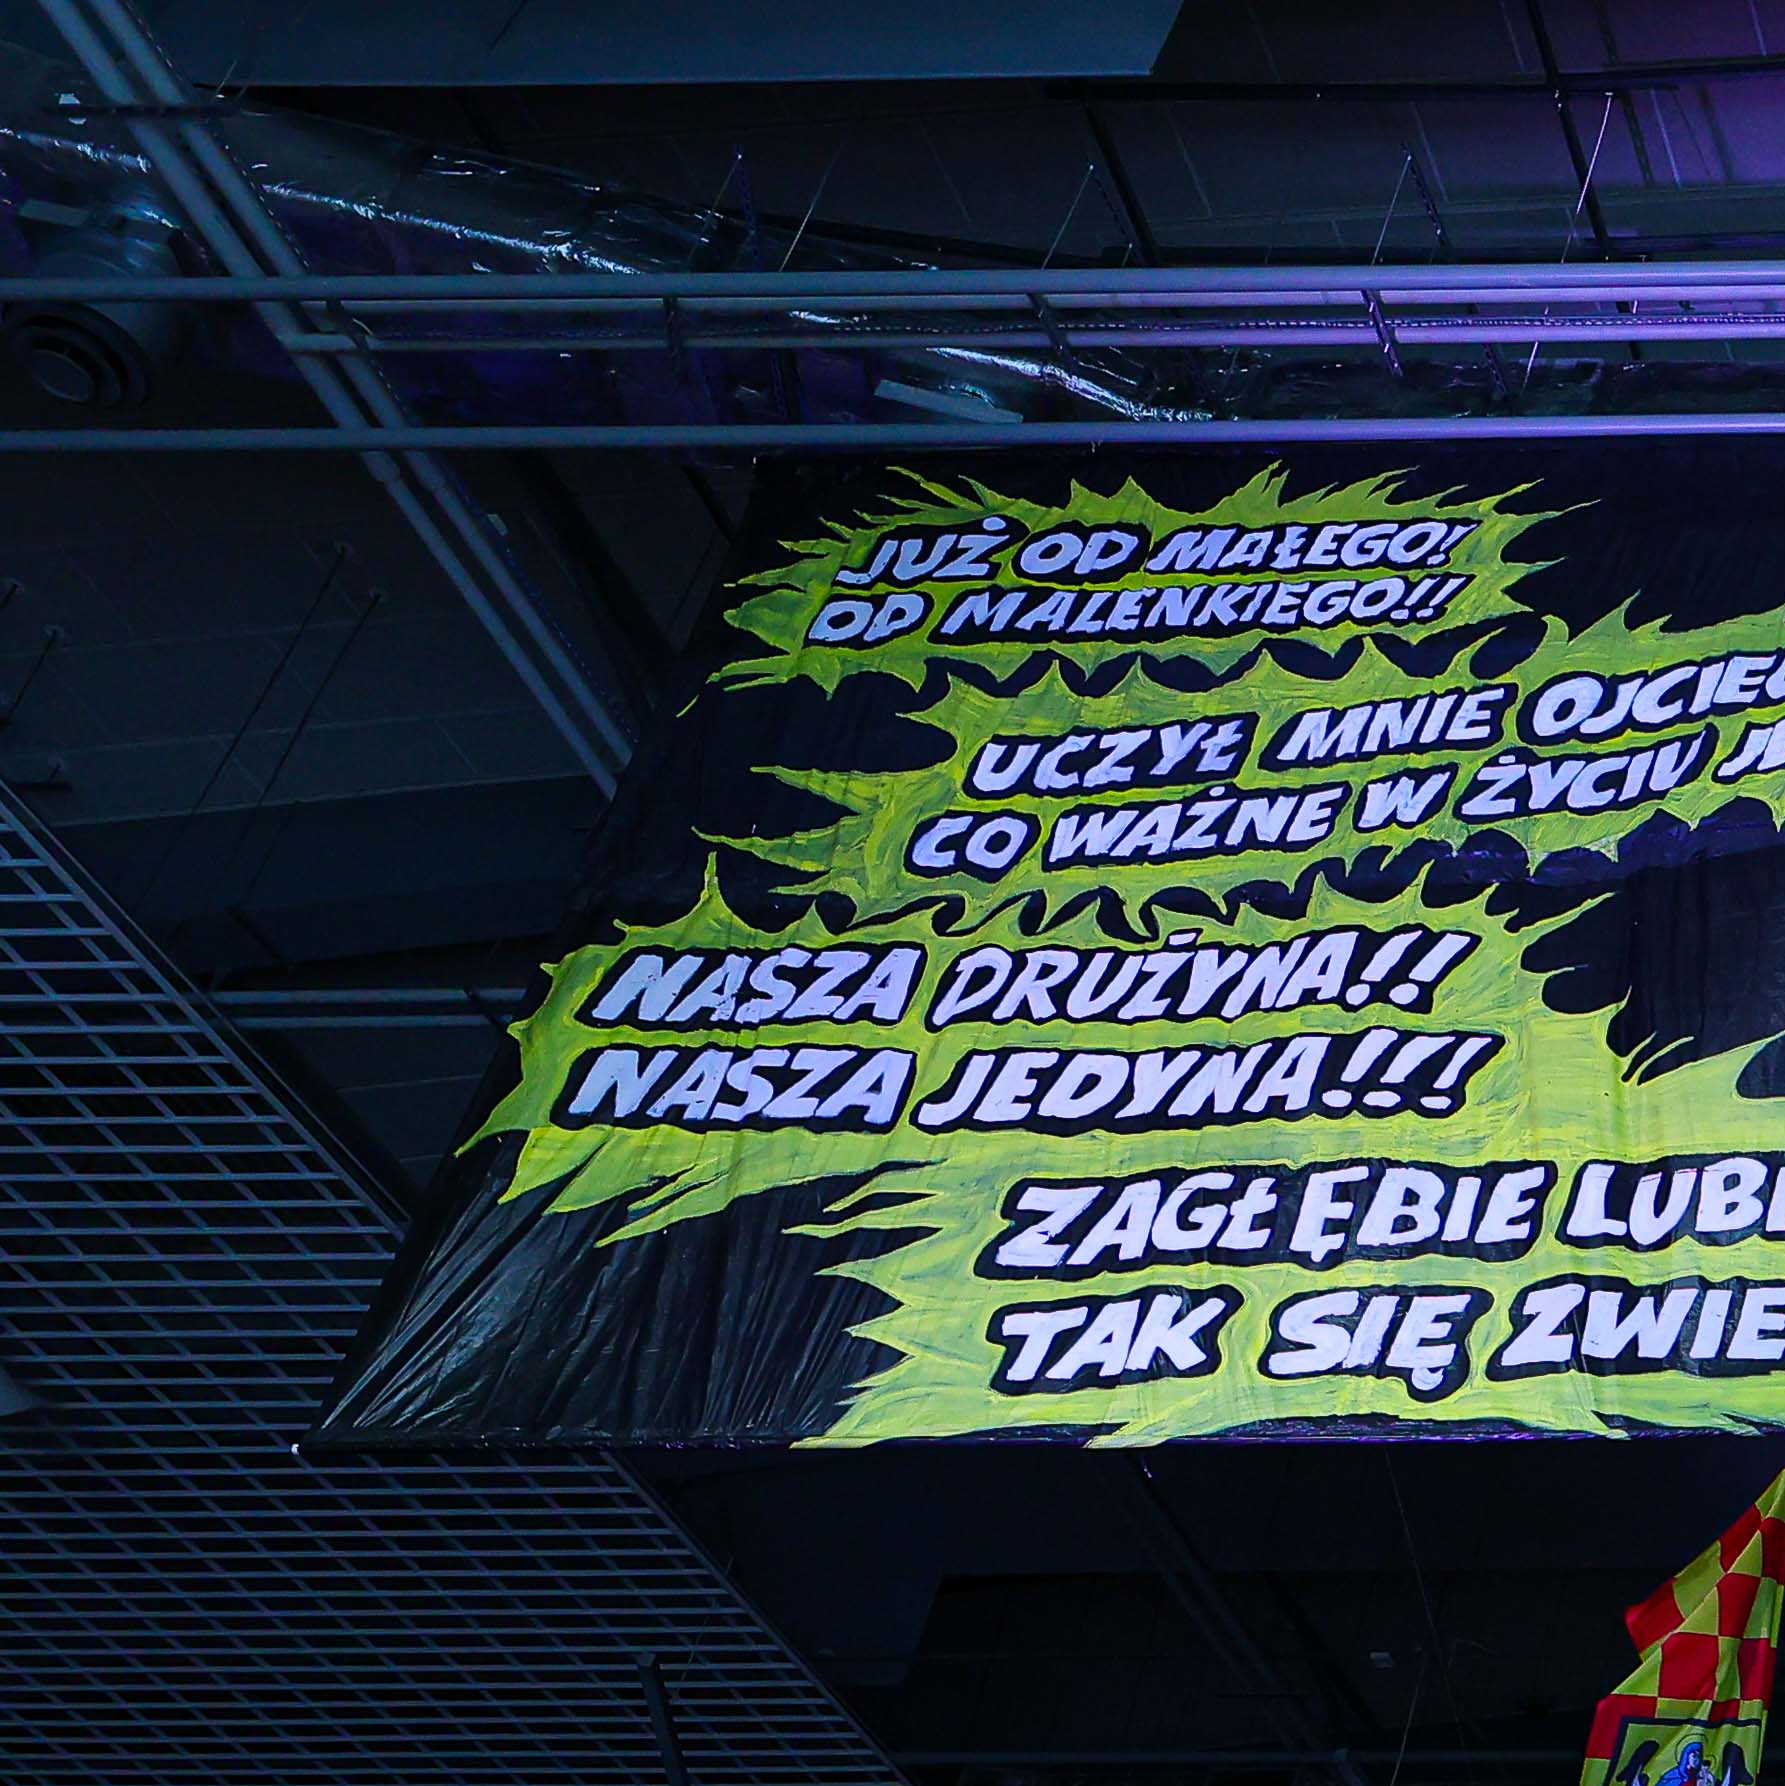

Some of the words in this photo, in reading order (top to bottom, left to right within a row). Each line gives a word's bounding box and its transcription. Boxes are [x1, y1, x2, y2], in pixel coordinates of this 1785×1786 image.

[836, 517, 1012, 584] JUŻ
[1019, 530, 1138, 576] OD
[1145, 521, 1479, 574] MAŁEGO!
[808, 597, 926, 642] OD
[944, 574, 1466, 635] MALENKIEGO!!
[973, 719, 1255, 792] UCZYŁ
[1281, 684, 1497, 761] MNIE
[910, 817, 1028, 870] CO
[1048, 784, 1333, 861] WAŻNE
[1360, 770, 1429, 825] W
[1462, 732, 1706, 819] ŻYCIU
[599, 950, 912, 1024] NASZA
[930, 929, 1455, 1028] DRUŻYNA!!
[569, 1049, 914, 1124] NASZA
[917, 1033, 1488, 1128] JEDYNA!!!
[999, 1299, 1226, 1382] TAK
[1268, 1293, 1472, 1390] SIĘ
